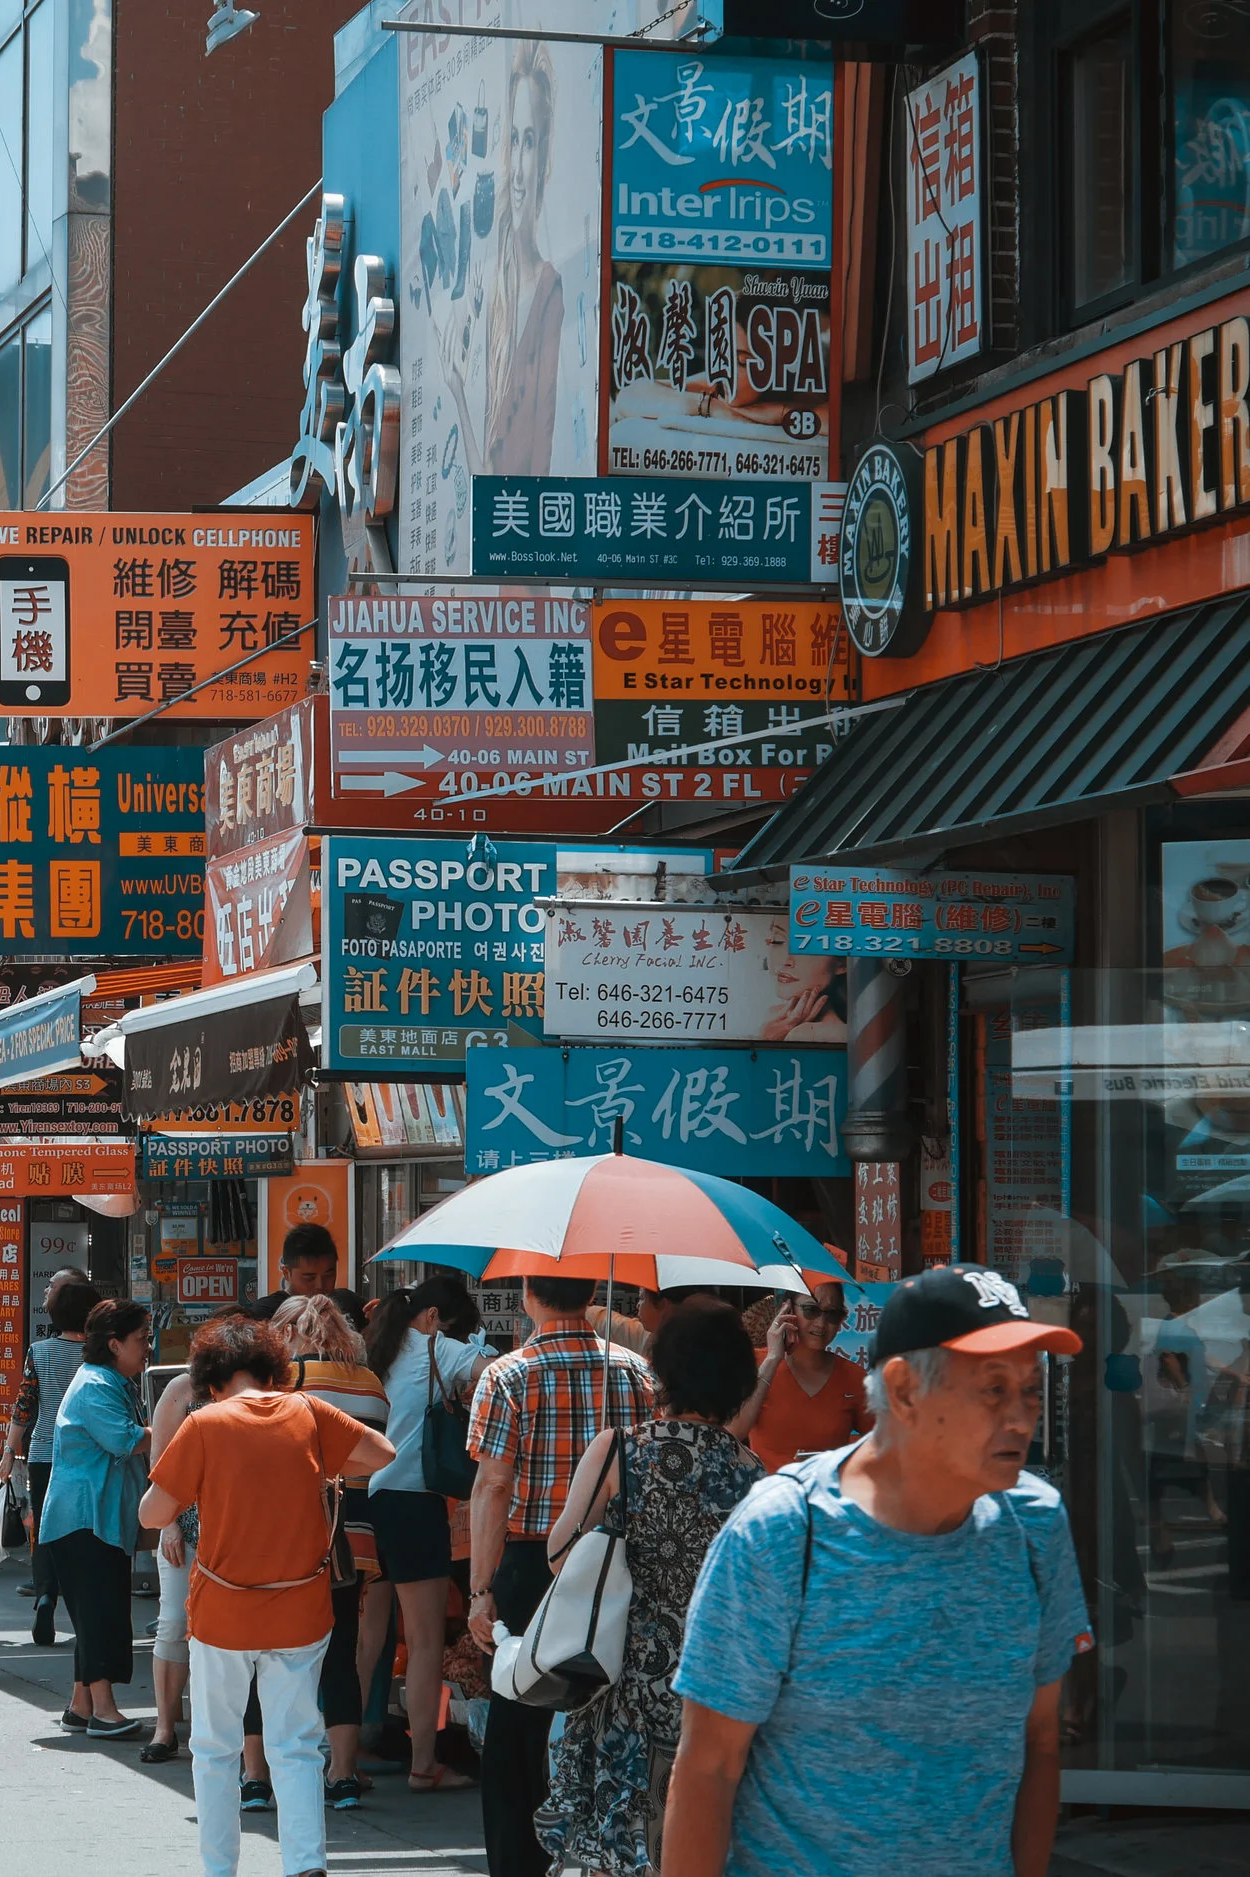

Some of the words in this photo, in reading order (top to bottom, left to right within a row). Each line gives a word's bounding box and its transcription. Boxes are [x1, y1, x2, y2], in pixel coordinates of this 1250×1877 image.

[618, 61, 833, 171] 文景假期
[619, 230, 824, 257] 718-412-0111
[742, 274, 790, 298] Shuxin
[791, 276, 830, 304] Yuan
[745, 304, 827, 394] SPA
[789, 411, 816, 436] 3B
[612, 447, 640, 469] TEL:
[643, 448, 733, 477] 646-266-7771,
[735, 453, 821, 477] 646-321-6475
[923, 390, 1071, 612] MAXIN
[491, 488, 802, 544] 美國職業介紹所
[25, 526, 93, 546] REPAIR
[112, 527, 187, 546] UNLOCK
[192, 528, 302, 548] CELLPHONE
[489, 550, 578, 565] www.Bosslook.Net
[596, 553, 622, 565] 40-06
[625, 553, 646, 565] Main
[649, 554, 660, 565] ST
[663, 554, 678, 565] #3C
[695, 554, 715, 566] Tel:
[720, 554, 787, 568] 929.369.1888
[113, 557, 198, 600] 維修
[217, 558, 302, 601] 解碼
[11, 584, 54, 673] 手機
[332, 599, 425, 634] JIAHUA
[432, 600, 535, 634] SERVICE
[544, 601, 587, 635] INC
[114, 609, 198, 651] 開臺
[218, 610, 302, 652] 充值
[114, 661, 198, 704] 買賣
[273, 672, 299, 686] #H2
[332, 641, 587, 710] 名扬移民入籍
[623, 672, 638, 689] E
[644, 672, 694, 690] Star
[699, 673, 836, 695] Technology
[210, 688, 299, 702] 718-581-6677
[338, 721, 363, 738] TEL:
[366, 715, 471, 738] 929.329.0370
[484, 716, 587, 738] 929.300.8788
[447, 749, 501, 765] 40-06
[507, 750, 558, 765] MAIN
[565, 750, 590, 766] ST
[627, 743, 688, 766] Mail
[699, 744, 753, 766] Box
[761, 743, 808, 766] For
[438, 771, 533, 797] 40-06
[543, 771, 631, 798] MAIN
[641, 773, 684, 798] ST
[693, 773, 714, 797] 2
[723, 773, 762, 797] FL
[413, 807, 487, 822] 40-10
[337, 857, 548, 893] PASSPORT
[812, 876, 846, 892] Star
[849, 877, 937, 899] Technology
[411, 900, 546, 934] PHOTO
[341, 938, 377, 957] FOTO
[381, 939, 463, 960] PASAPORTE
[473, 941, 545, 963] 여권사진
[793, 933, 1013, 956] 718.321.8808
[581, 952, 631, 970] Cherry
[342, 965, 545, 1019] 証件快照
[555, 981, 590, 1001] Tel:
[597, 982, 730, 1005] 646-321-6475
[597, 1009, 729, 1031] 646-266-7771
[27, 1022, 56, 1056] SPECIAL
[55, 1013, 77, 1047] PRICE
[359, 1027, 459, 1046] 美東地面店
[359, 1045, 396, 1056] EAST
[400, 1046, 437, 1057] MALL
[481, 1056, 840, 1159] 文景假期
[29, 1146, 93, 1160] Tempered
[94, 1146, 129, 1157] Glass
[147, 1140, 232, 1156] PASSPORT
[235, 1138, 290, 1154] PHOTO
[27, 1161, 85, 1186] 贴膜
[148, 1156, 244, 1177] 証件快照
[182, 1275, 234, 1298] OPEN
